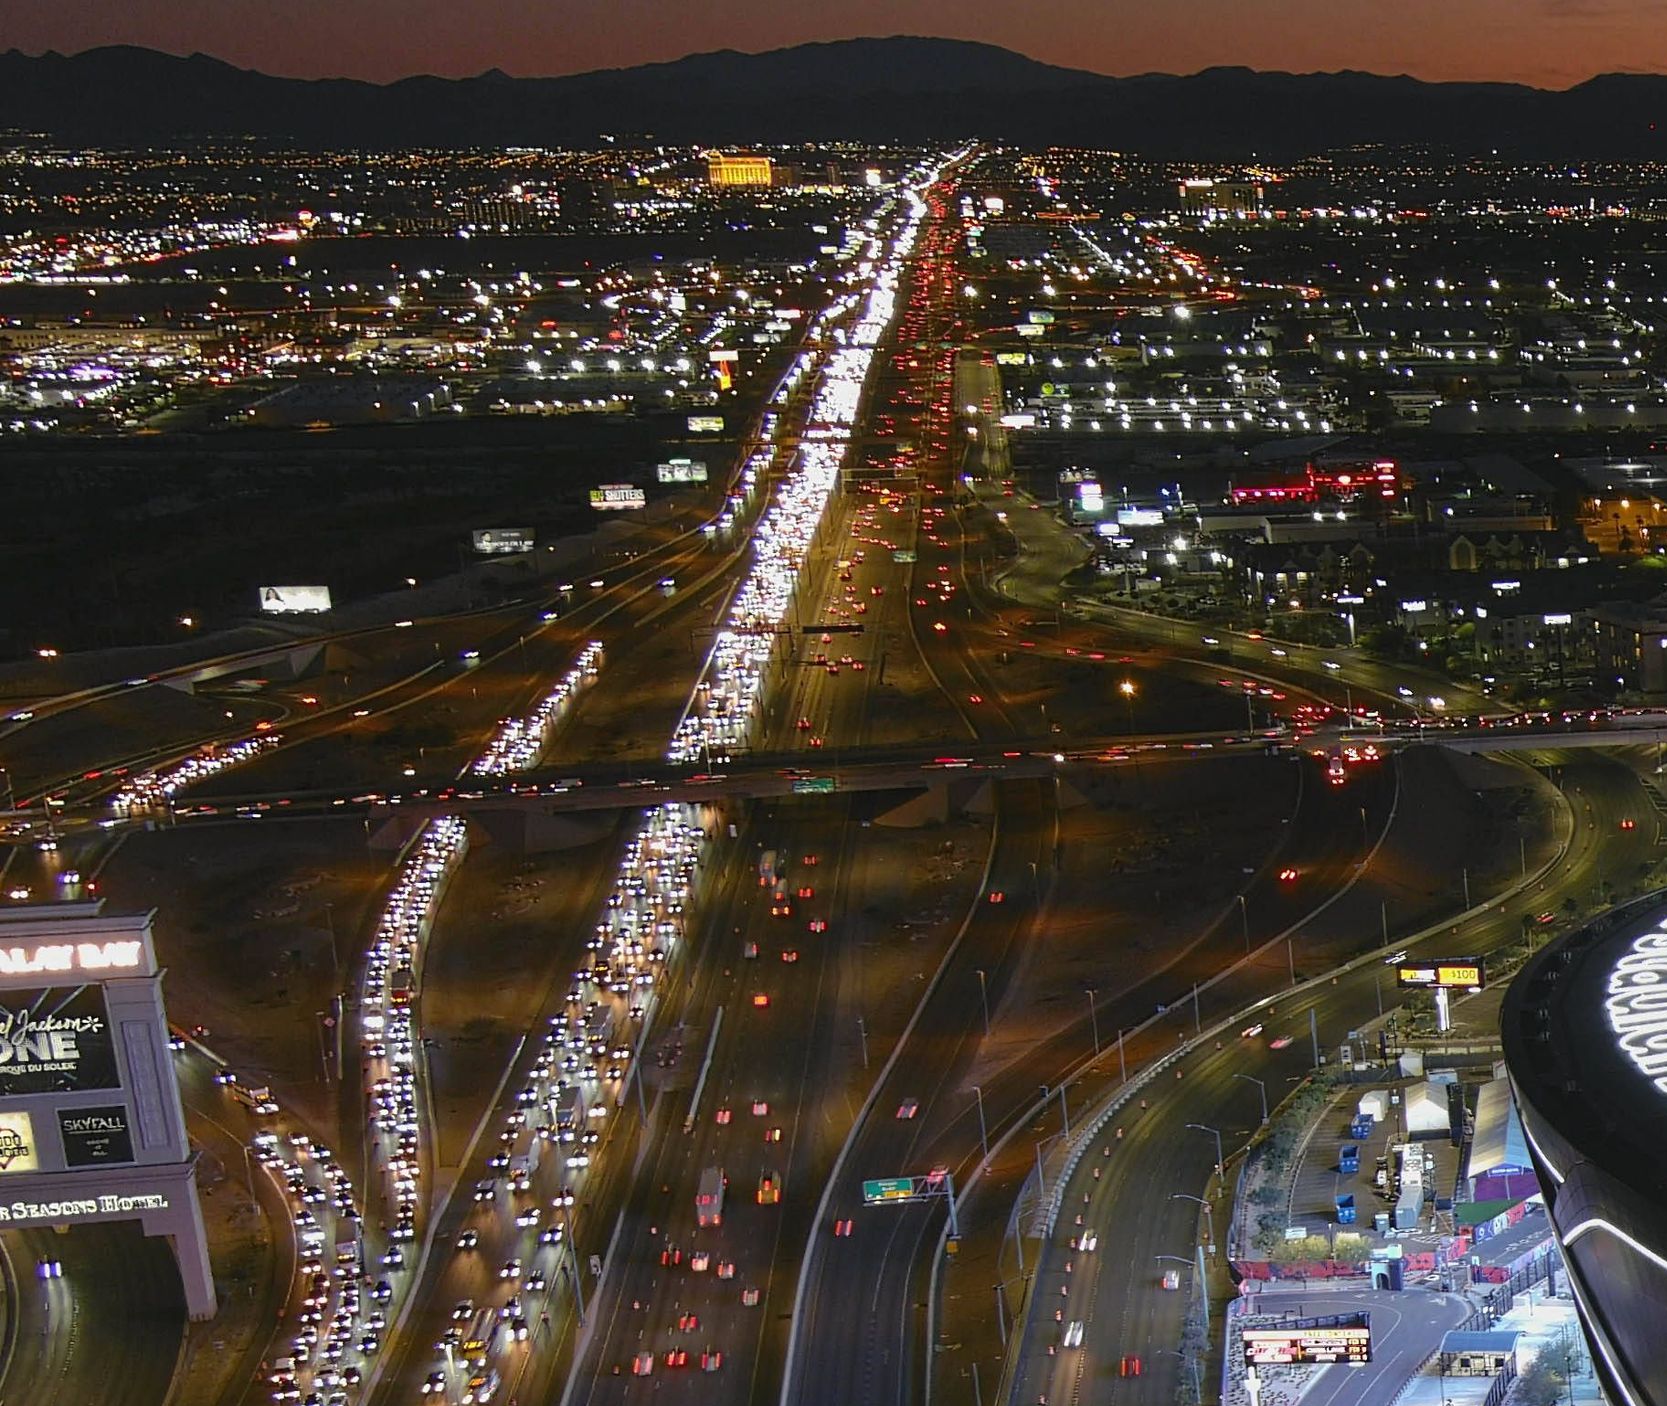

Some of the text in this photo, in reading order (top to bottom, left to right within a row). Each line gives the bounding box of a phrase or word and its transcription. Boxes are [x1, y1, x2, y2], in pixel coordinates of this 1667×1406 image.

[64, 1117, 125, 1131] SKYFALL
[12, 1201, 97, 1219] SEASONS
[97, 1194, 168, 1213] HOTEL
